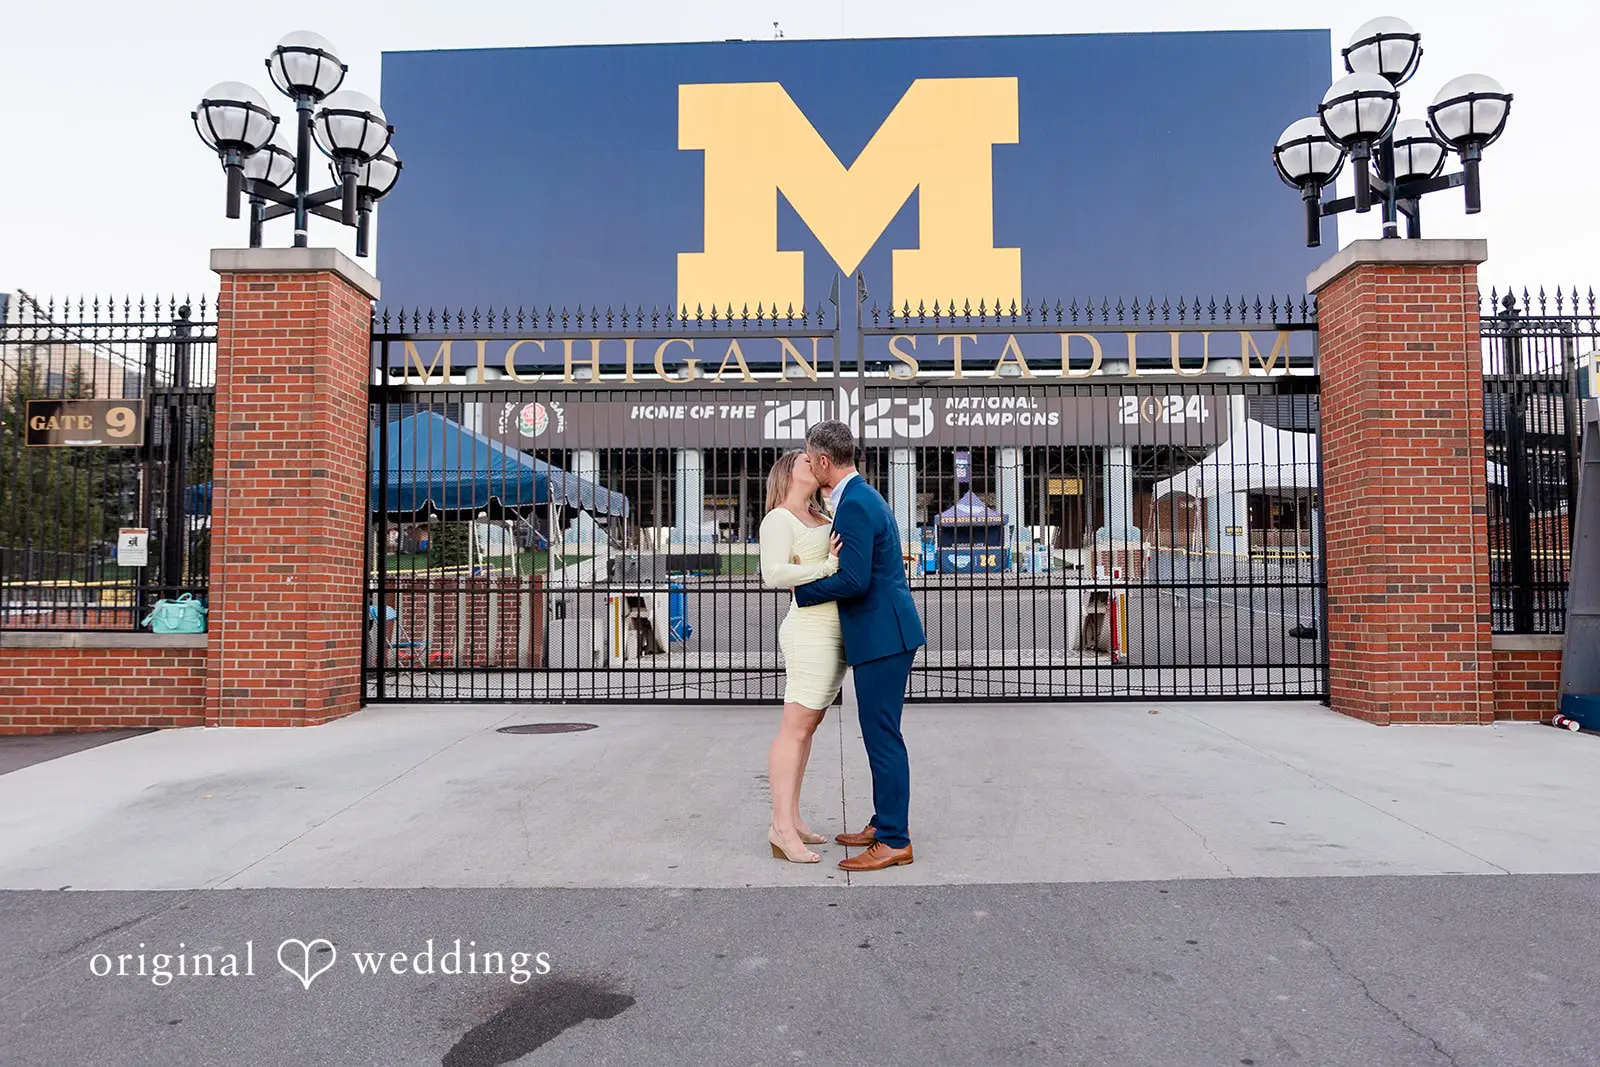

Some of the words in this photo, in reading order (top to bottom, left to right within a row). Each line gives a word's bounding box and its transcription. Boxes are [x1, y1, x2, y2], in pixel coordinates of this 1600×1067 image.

[676, 76, 1022, 320] M
[403, 337, 820, 385] MICHIGAN
[887, 330, 1291, 380] STADIUM
[631, 405, 687, 419] HOME
[690, 405, 715, 419] OF
[719, 405, 757, 419] THE
[945, 396, 1038, 409] NATIONAL
[30, 415, 93, 431] GATE
[105, 407, 136, 438] 9
[945, 412, 1060, 426] CHAMPIONS
